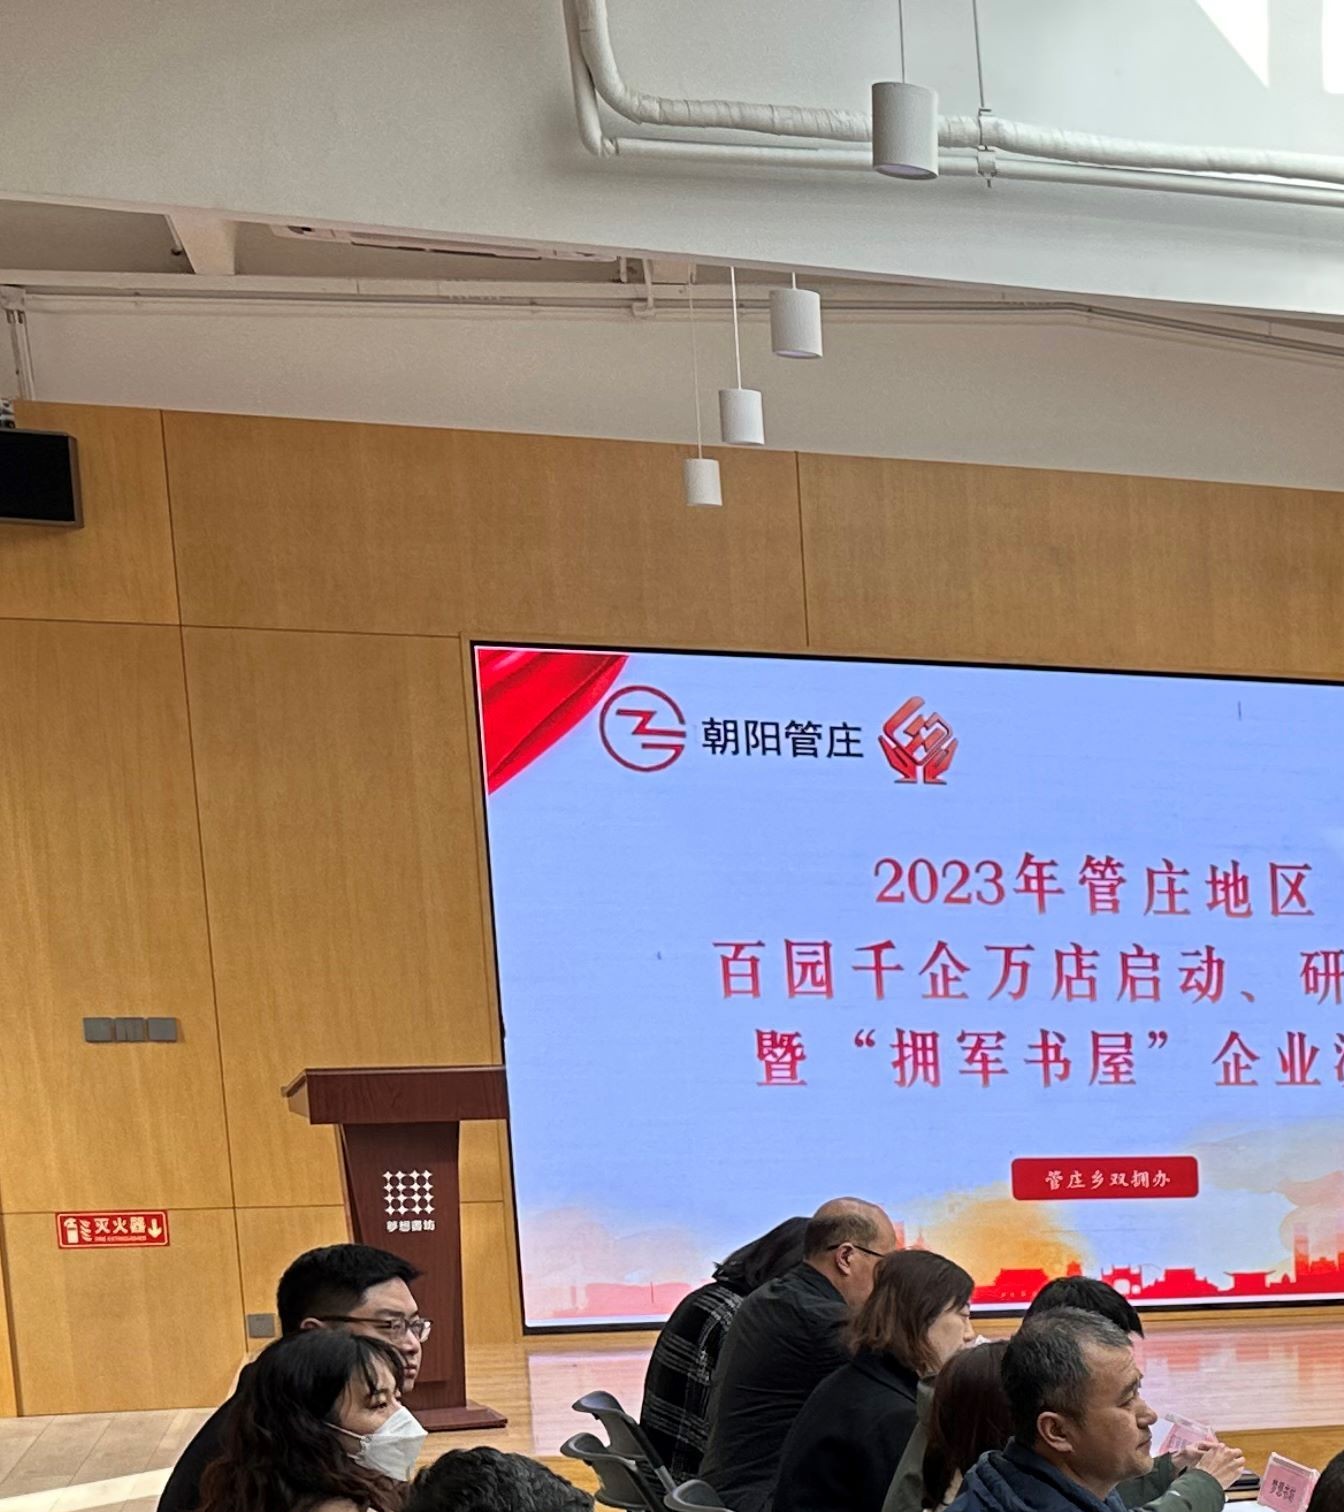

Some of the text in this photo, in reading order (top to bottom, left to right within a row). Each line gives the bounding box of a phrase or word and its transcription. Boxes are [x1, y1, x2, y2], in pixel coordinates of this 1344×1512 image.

[701, 717, 864, 759] 朝阳管庄
[873, 851, 1315, 918] 2023年管庄地区
[1045, 1169, 1170, 1191] 管庄乡双拥办
[93, 1216, 146, 1234] 灭火器
